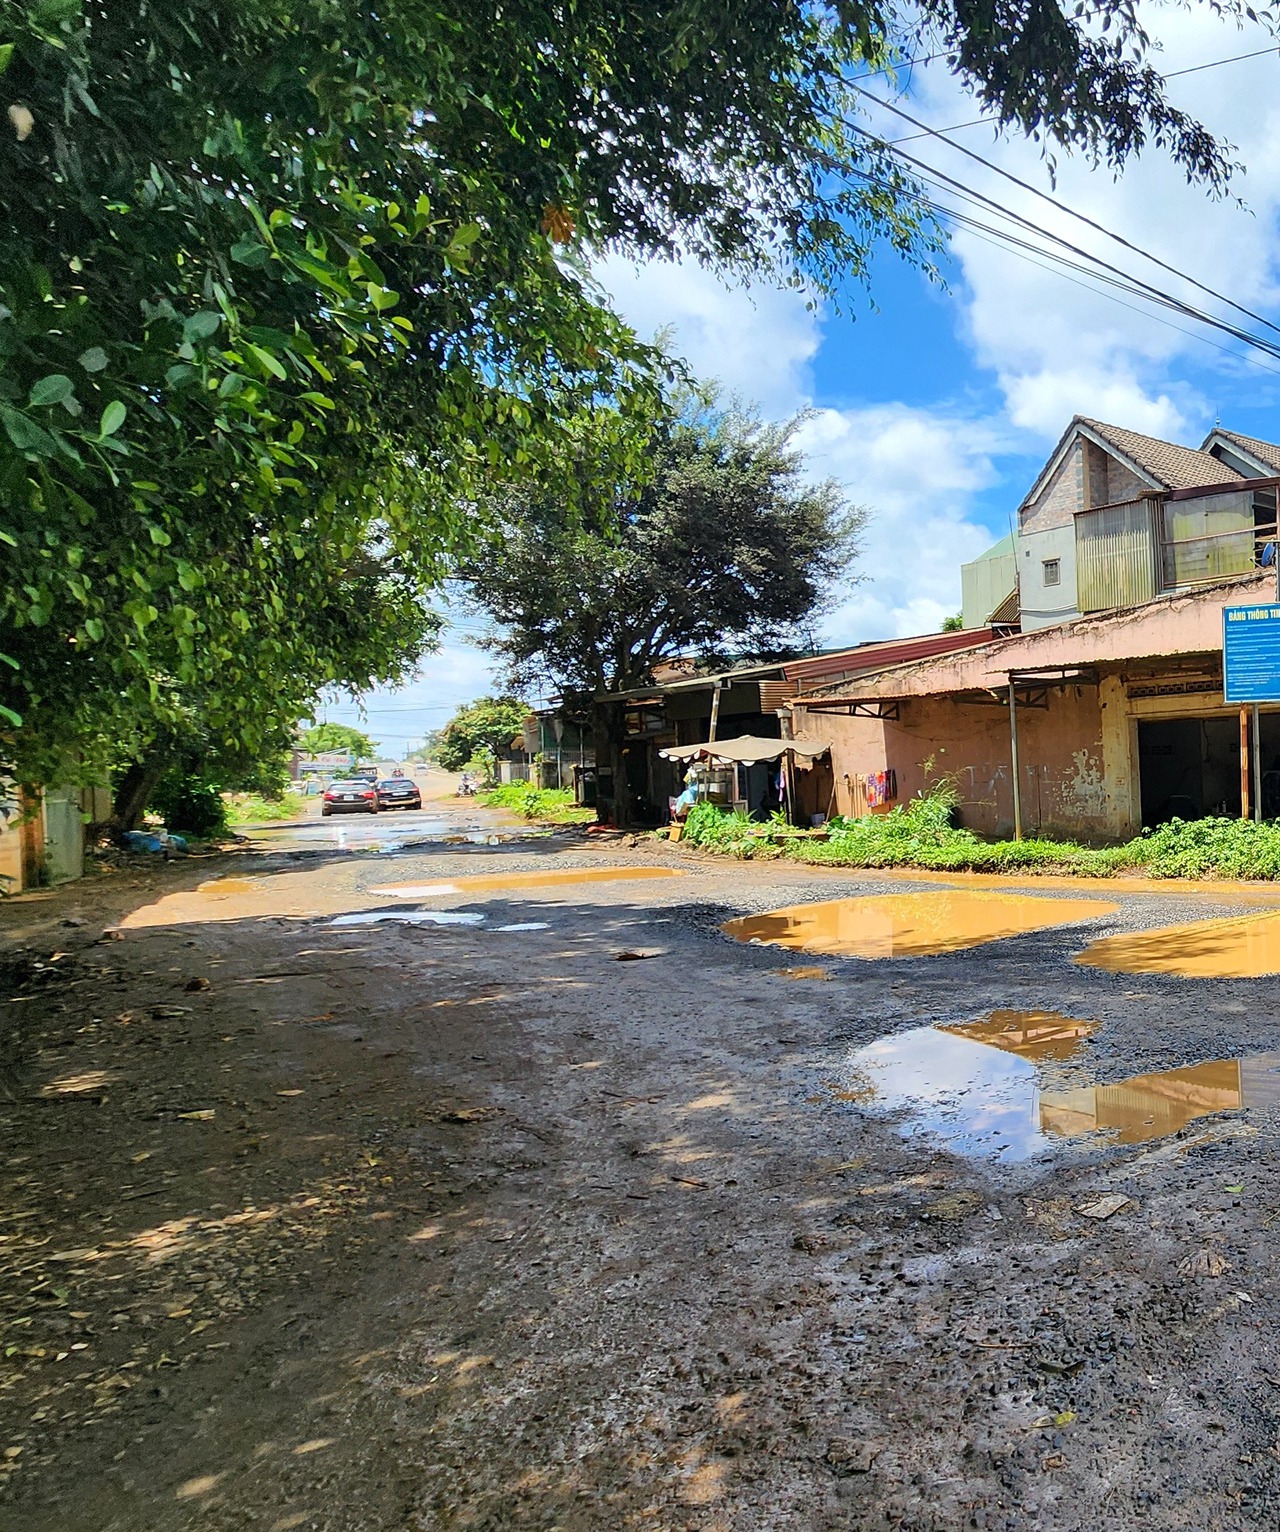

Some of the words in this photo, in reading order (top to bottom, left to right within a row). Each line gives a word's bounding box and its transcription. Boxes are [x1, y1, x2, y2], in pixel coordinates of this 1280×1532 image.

[1228, 610, 1246, 621] BẢNG
[1247, 608, 1268, 620] THÔNG
[1270, 609, 1280, 619] TIN
